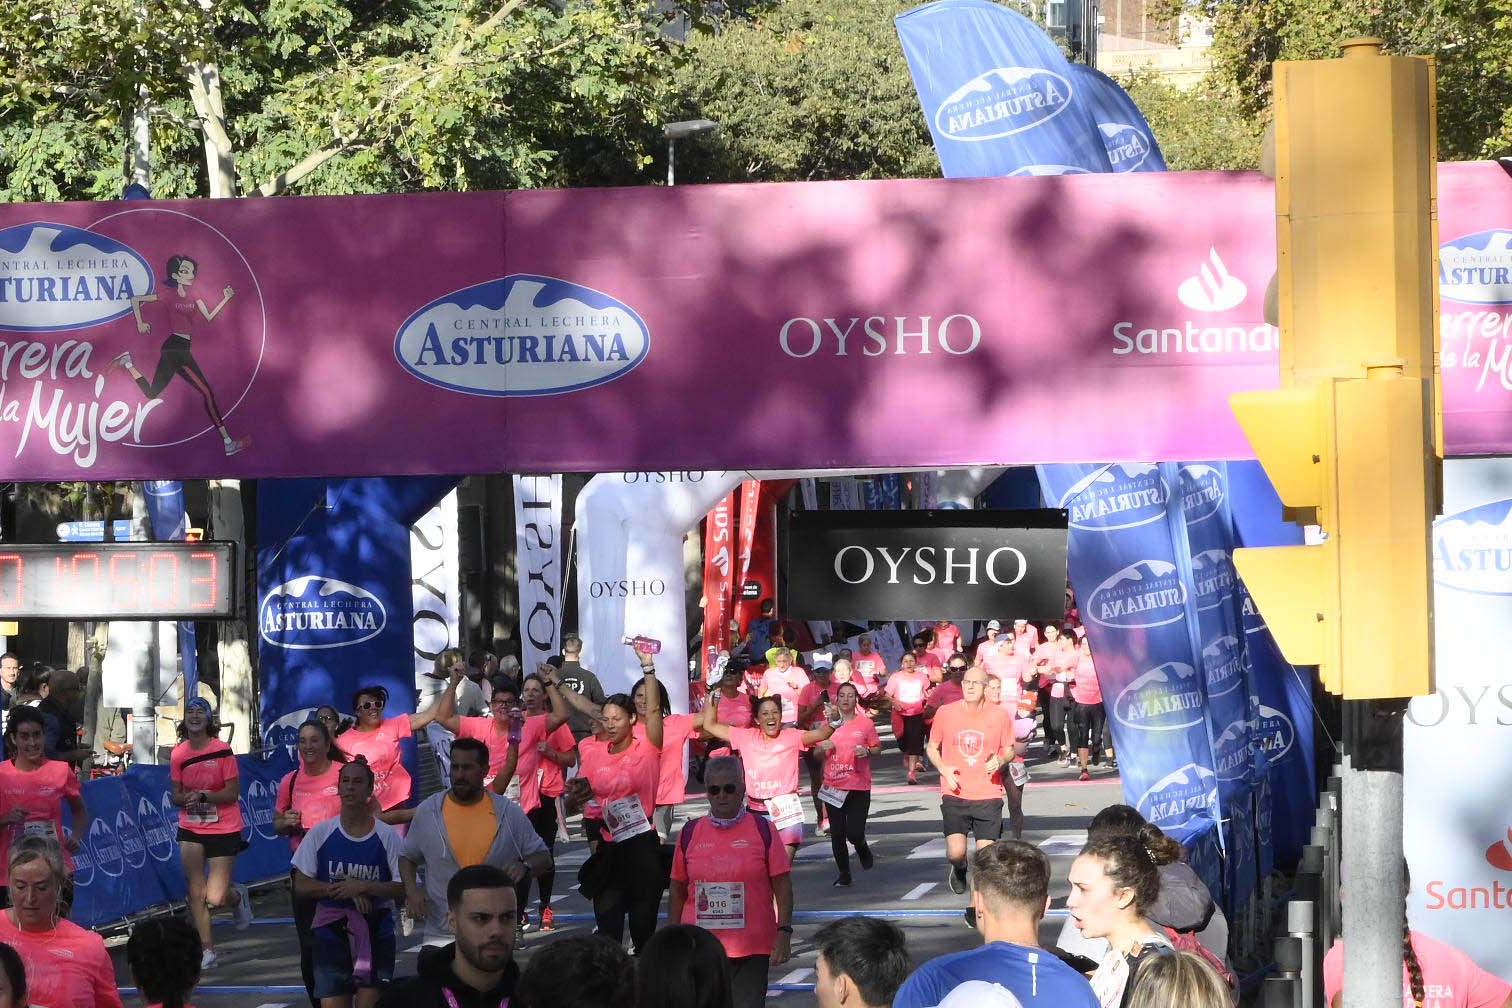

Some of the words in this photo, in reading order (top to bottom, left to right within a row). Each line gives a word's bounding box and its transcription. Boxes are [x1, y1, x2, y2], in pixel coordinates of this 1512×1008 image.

[56, 258, 129, 269] LECHERA
[454, 317, 531, 330] CENTRAL
[541, 315, 621, 328] LECHERA
[779, 314, 982, 358] OYSHO
[414, 322, 630, 366] ASTURIANA
[1112, 321, 1280, 355] Santand
[15, 374, 164, 468] Mujer
[834, 545, 1027, 586] OYSHO
[591, 579, 666, 599] OYSHO
[264, 605, 377, 633] ASTURIANA
[328, 860, 344, 876] LA
[346, 863, 381, 880] MINA
[710, 900, 727, 908] 016
